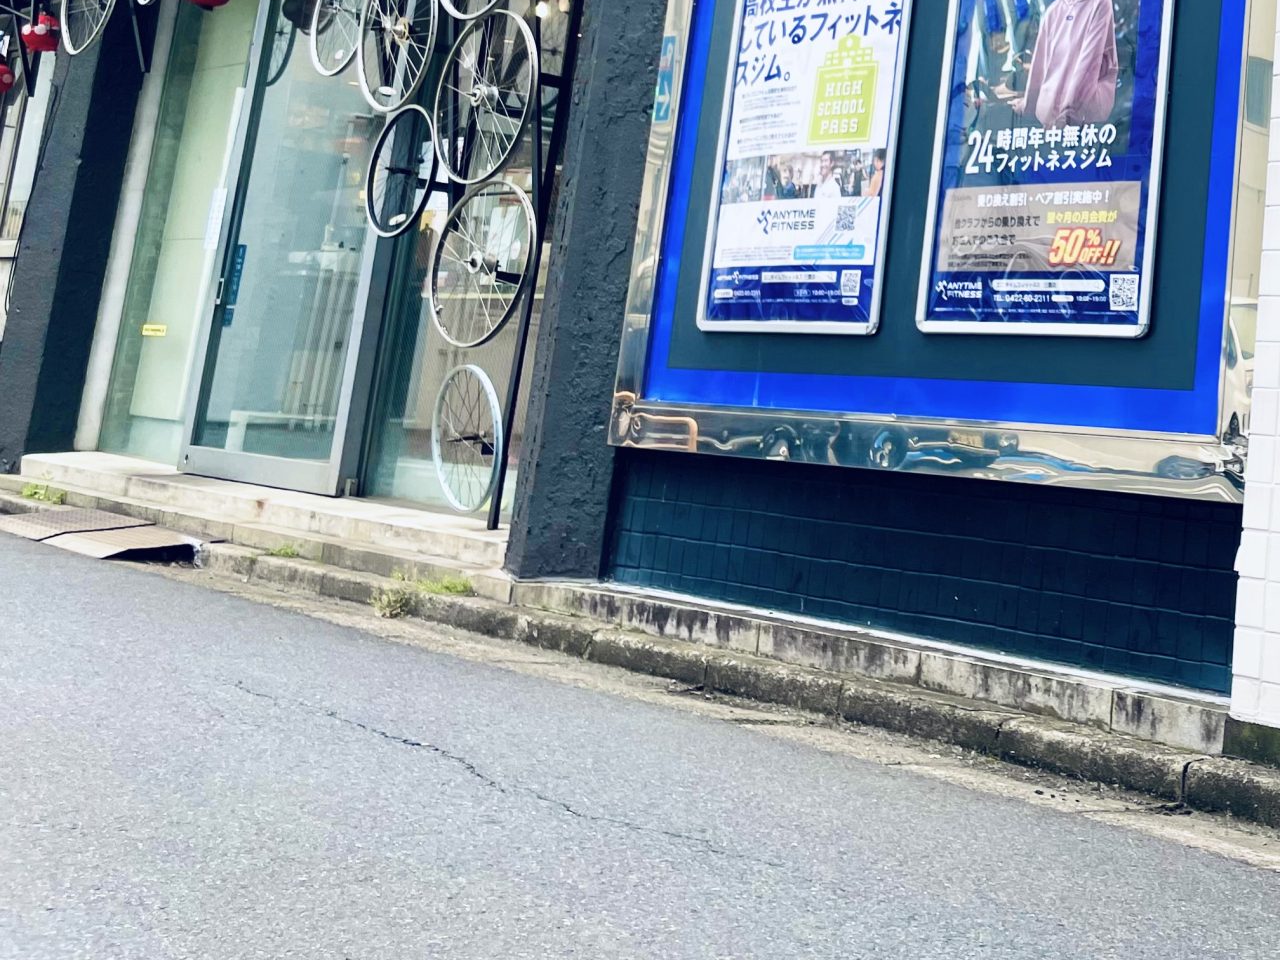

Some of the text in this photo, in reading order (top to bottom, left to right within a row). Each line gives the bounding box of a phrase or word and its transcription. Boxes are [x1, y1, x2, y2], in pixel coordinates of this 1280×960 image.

[824, 79, 863, 98] HIGH
[816, 98, 866, 117] SCHOOL
[819, 118, 859, 136] PASS
[965, 129, 994, 175] 24
[996, 147, 1113, 173] フィットネスジム
[771, 208, 816, 220] ANYTIME
[770, 220, 815, 231] FITNESS
